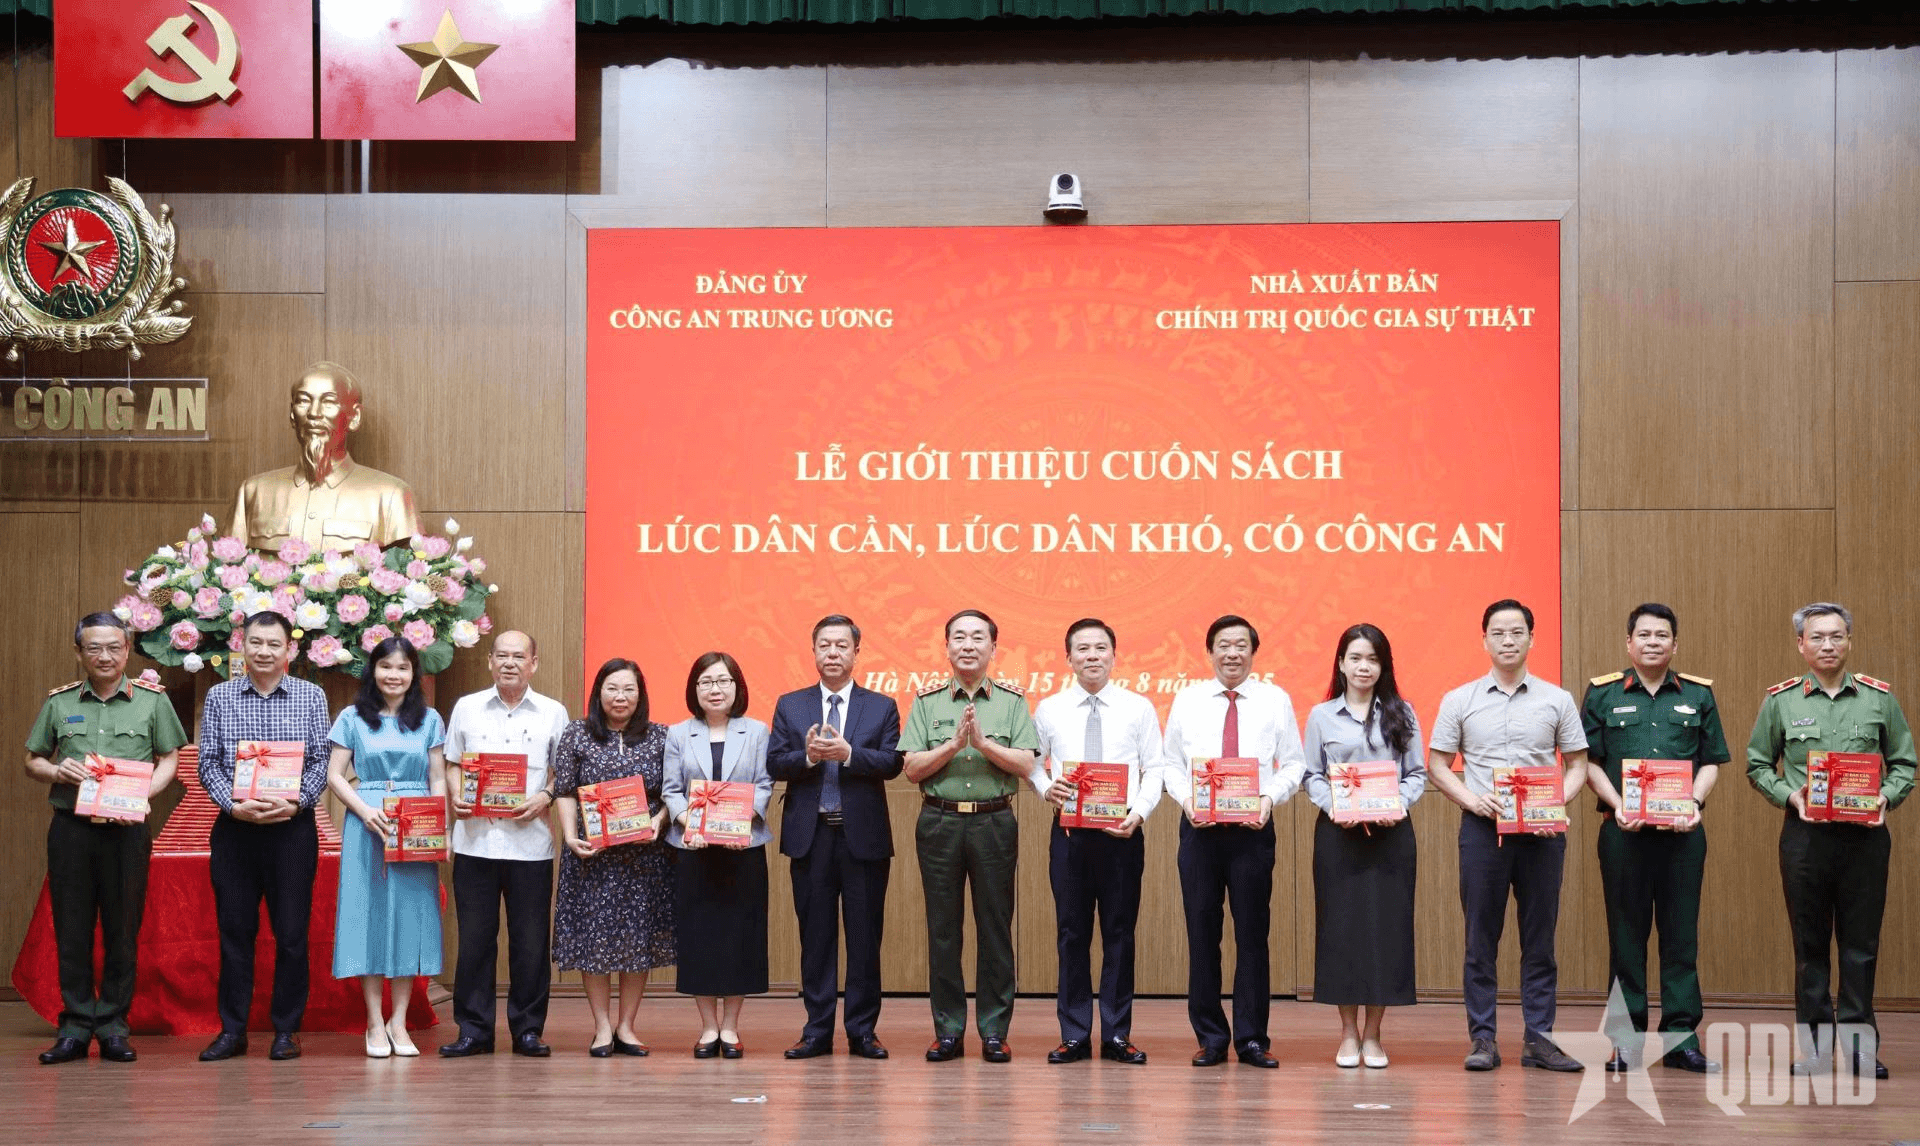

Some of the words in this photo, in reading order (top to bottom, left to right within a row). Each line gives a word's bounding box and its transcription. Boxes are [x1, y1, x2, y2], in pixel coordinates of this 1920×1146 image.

[695, 269, 767, 294] ĐẢNG
[773, 269, 808, 294] ỦY
[1250, 269, 1305, 294] NHÀ
[1311, 269, 1381, 294] XUẤT
[1387, 268, 1439, 293] BẢN
[609, 304, 682, 329] CÔNG
[686, 309, 721, 328] AN
[726, 309, 814, 329] TRUNG
[820, 306, 893, 328] ƯƠNG
[1155, 305, 1239, 330] CHÍNH
[1244, 309, 1287, 334] TRỊ
[1293, 304, 1368, 332] QUỐC
[1373, 308, 1420, 328] GIA
[1424, 305, 1461, 333] SỰ
[1464, 304, 1536, 333] THẬT
[14, 378, 135, 431] CÔNG
[146, 387, 206, 431] AN
[795, 443, 847, 481] LỄ
[858, 443, 951, 481] GIỚI
[961, 446, 1090, 488] THIỆU
[1101, 442, 1220, 481] CUỐN
[1231, 441, 1344, 480] SÁCH
[637, 515, 721, 553] LÚC
[731, 513, 818, 553] DÂN
[828, 514, 926, 559] CẦN,
[936, 514, 1020, 553] LÚC
[1030, 513, 1117, 553] DÂN
[1129, 514, 1233, 558] KHÓ,
[1243, 514, 1304, 553] CÓ
[1315, 513, 1438, 553] CÔNG
[1446, 522, 1506, 552] AN
[864, 671, 899, 693] Hà
[1027, 671, 1054, 693] 15
[1135, 671, 1151, 694] 8
